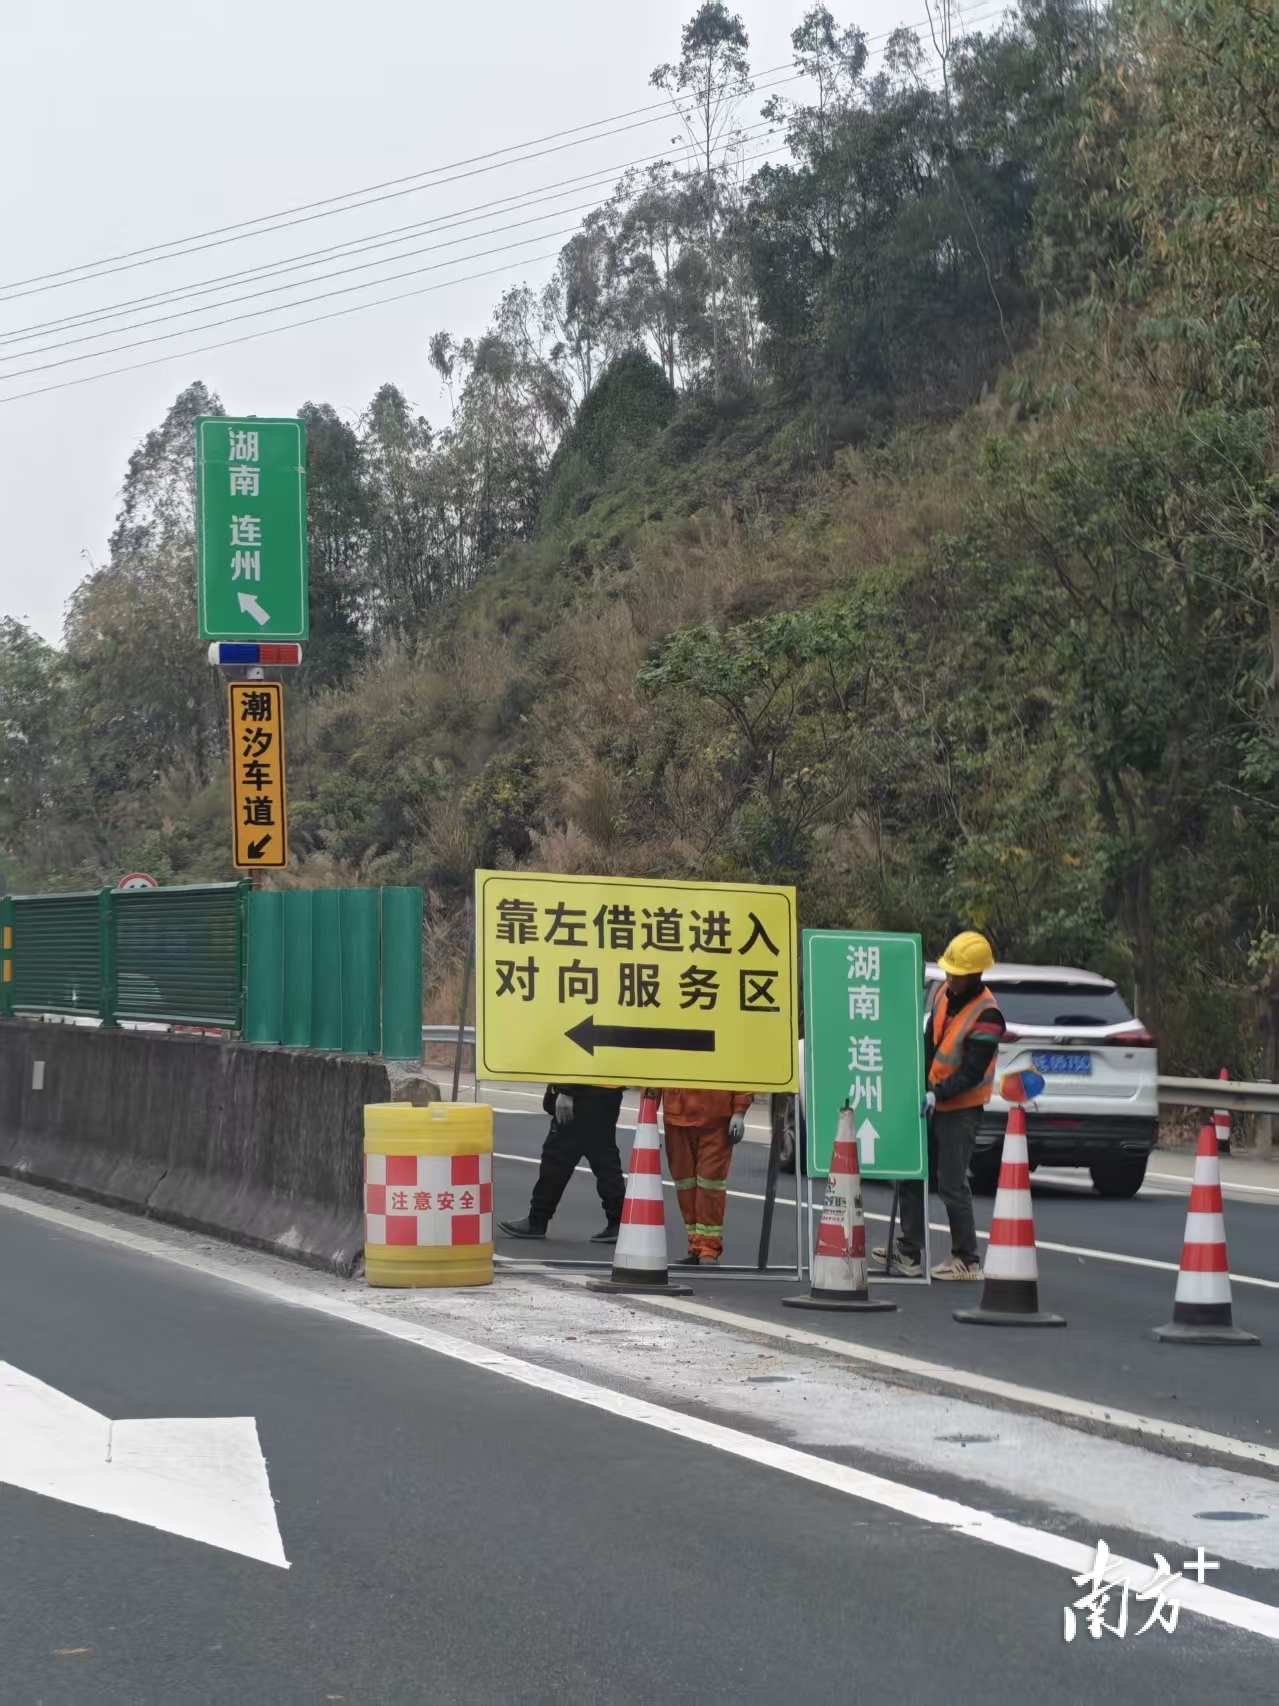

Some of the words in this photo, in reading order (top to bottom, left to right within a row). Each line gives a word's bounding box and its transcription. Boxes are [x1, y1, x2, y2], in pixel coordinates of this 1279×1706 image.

[228, 427, 261, 497] 湖南
[229, 514, 262, 582] 连州
[241, 691, 275, 826] 潮汐车道
[495, 898, 780, 957] 靠左借道进入
[495, 956, 780, 1012] 对向服务区
[846, 945, 881, 1021] 湖南
[848, 1036, 883, 1112] 连州
[391, 1190, 475, 1211] 注意安全
